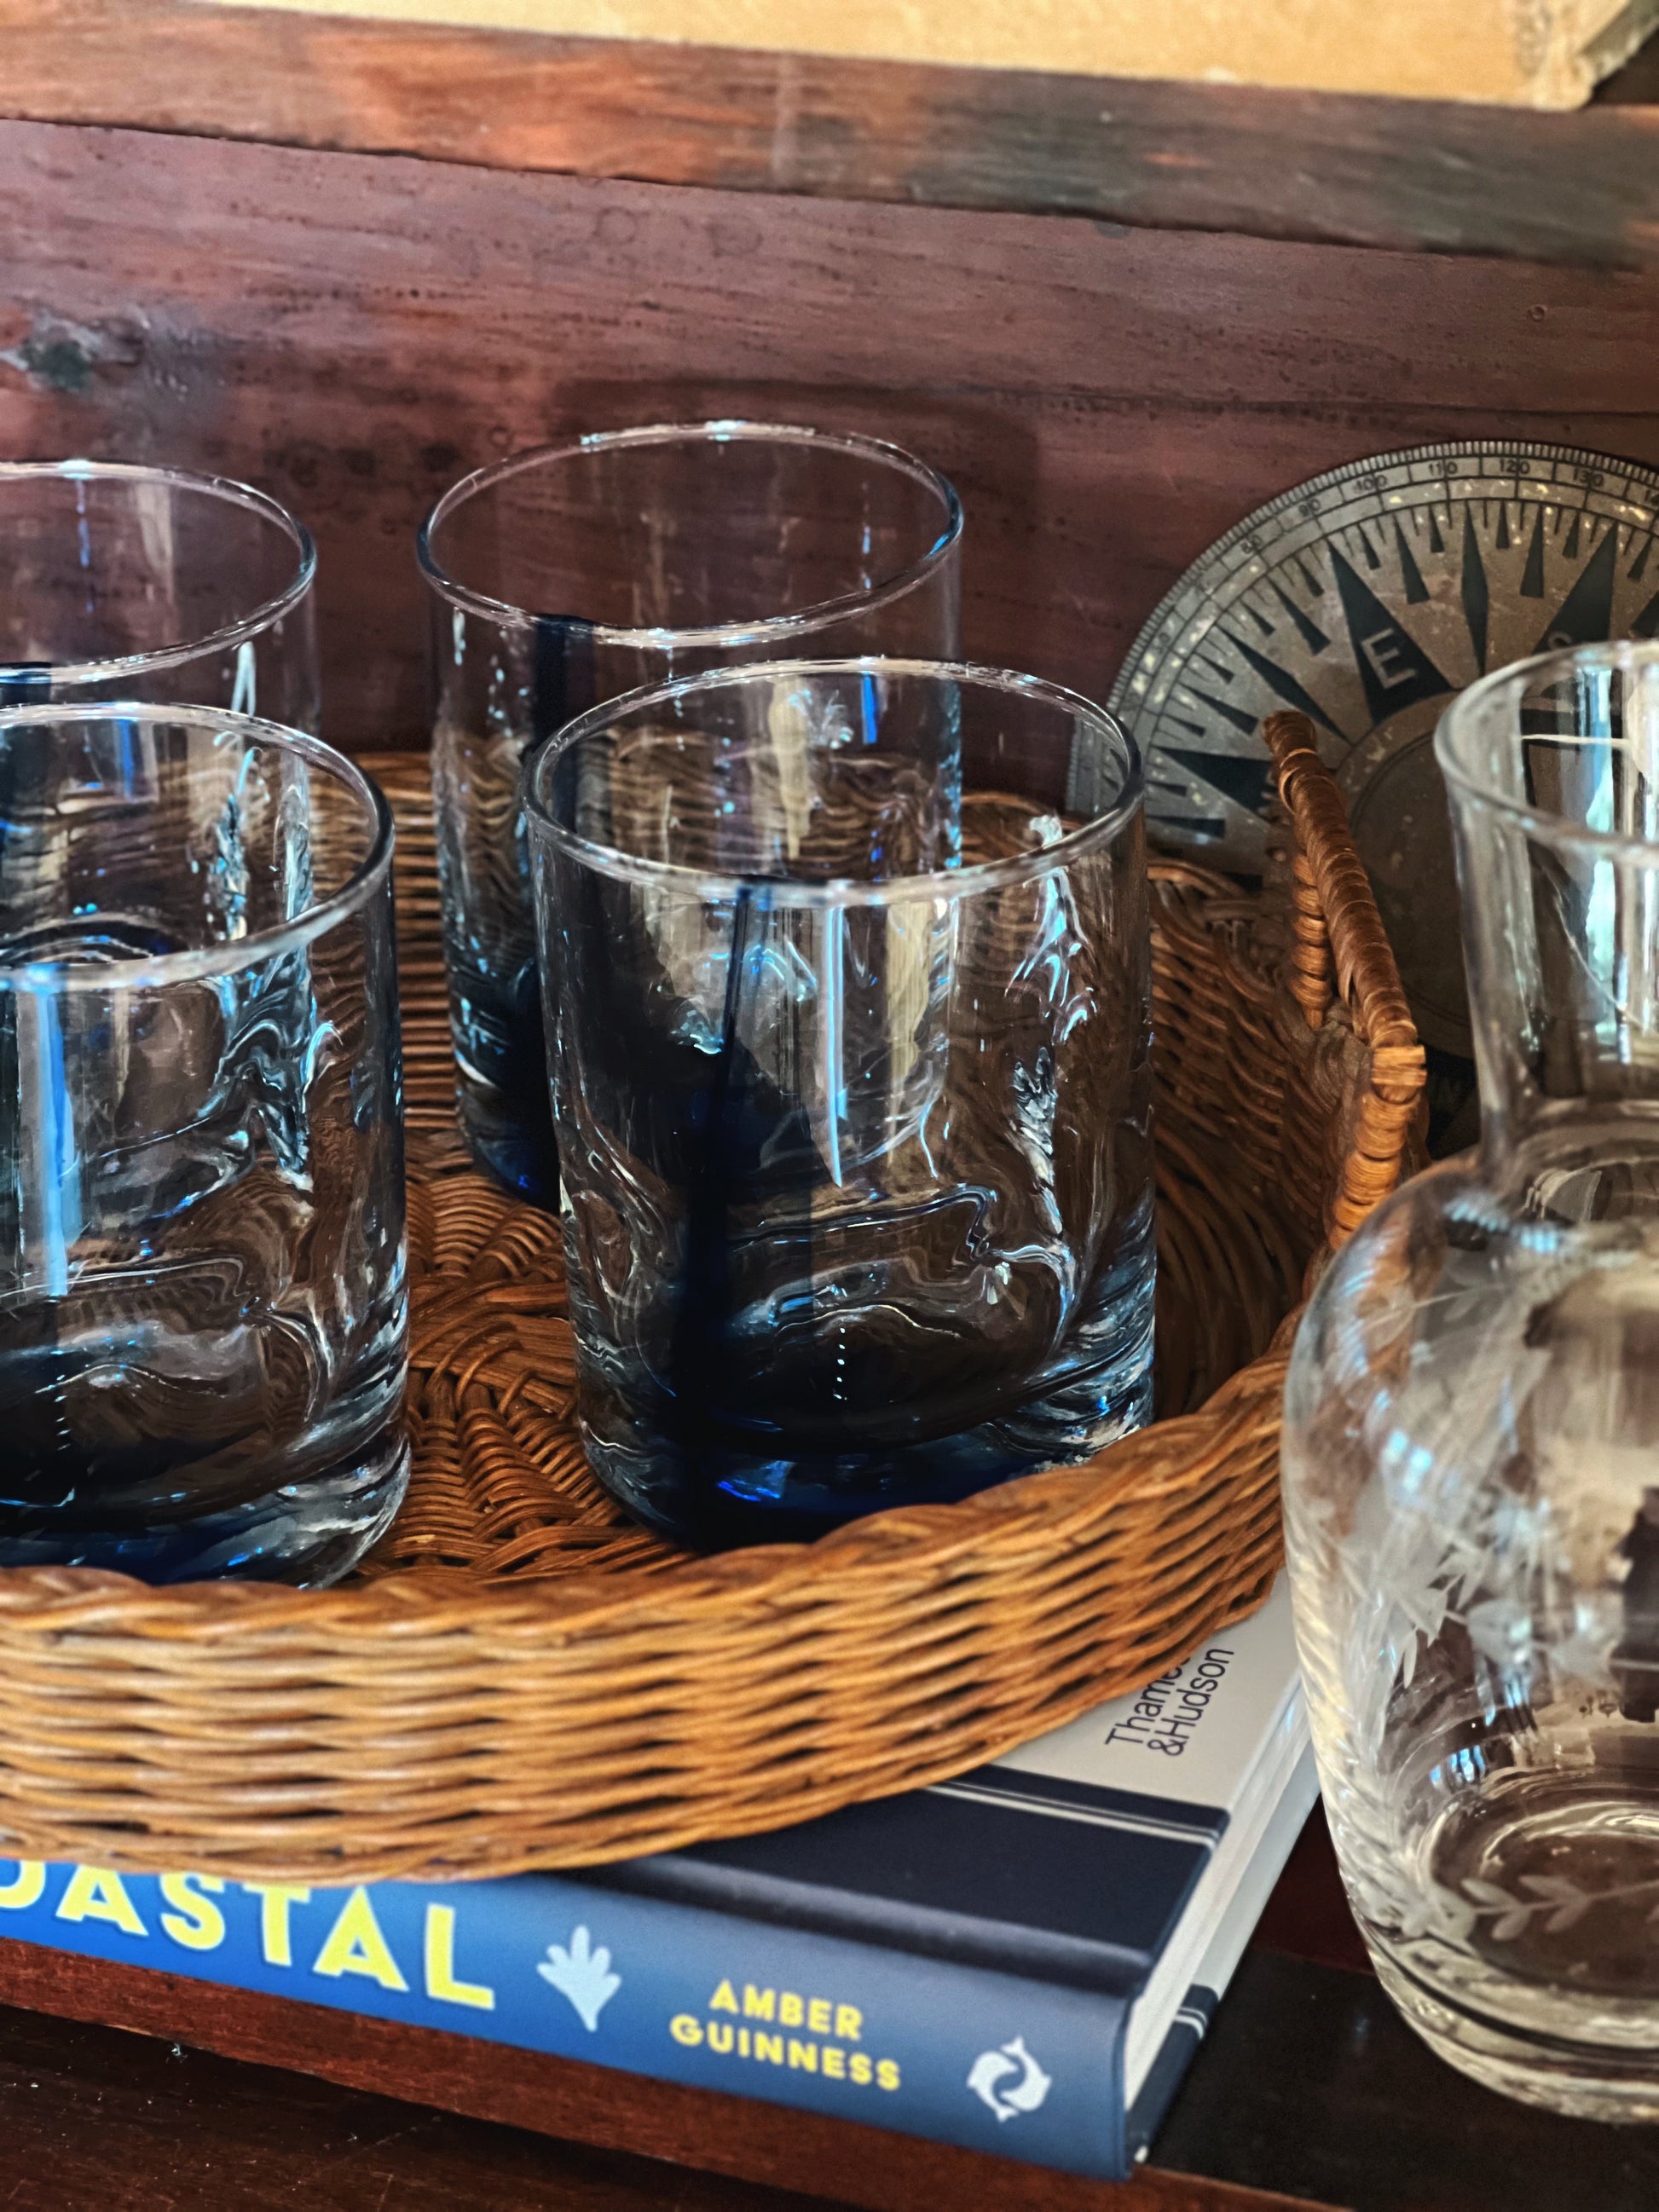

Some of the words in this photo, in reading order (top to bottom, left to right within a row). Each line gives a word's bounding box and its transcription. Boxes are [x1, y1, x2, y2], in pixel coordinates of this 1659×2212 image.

[1427, 461, 1459, 476] 110
[1499, 459, 1530, 475] 120
[1572, 468, 1604, 488] 130
[1240, 534, 1263, 555] 80
[1361, 627, 1418, 690] E
[1104, 1657, 1191, 1745] Thame
[1147, 1648, 1234, 1757] &Hudson
[709, 1978, 864, 2042] AMBER
[670, 2013, 901, 2092] GUINNESS
